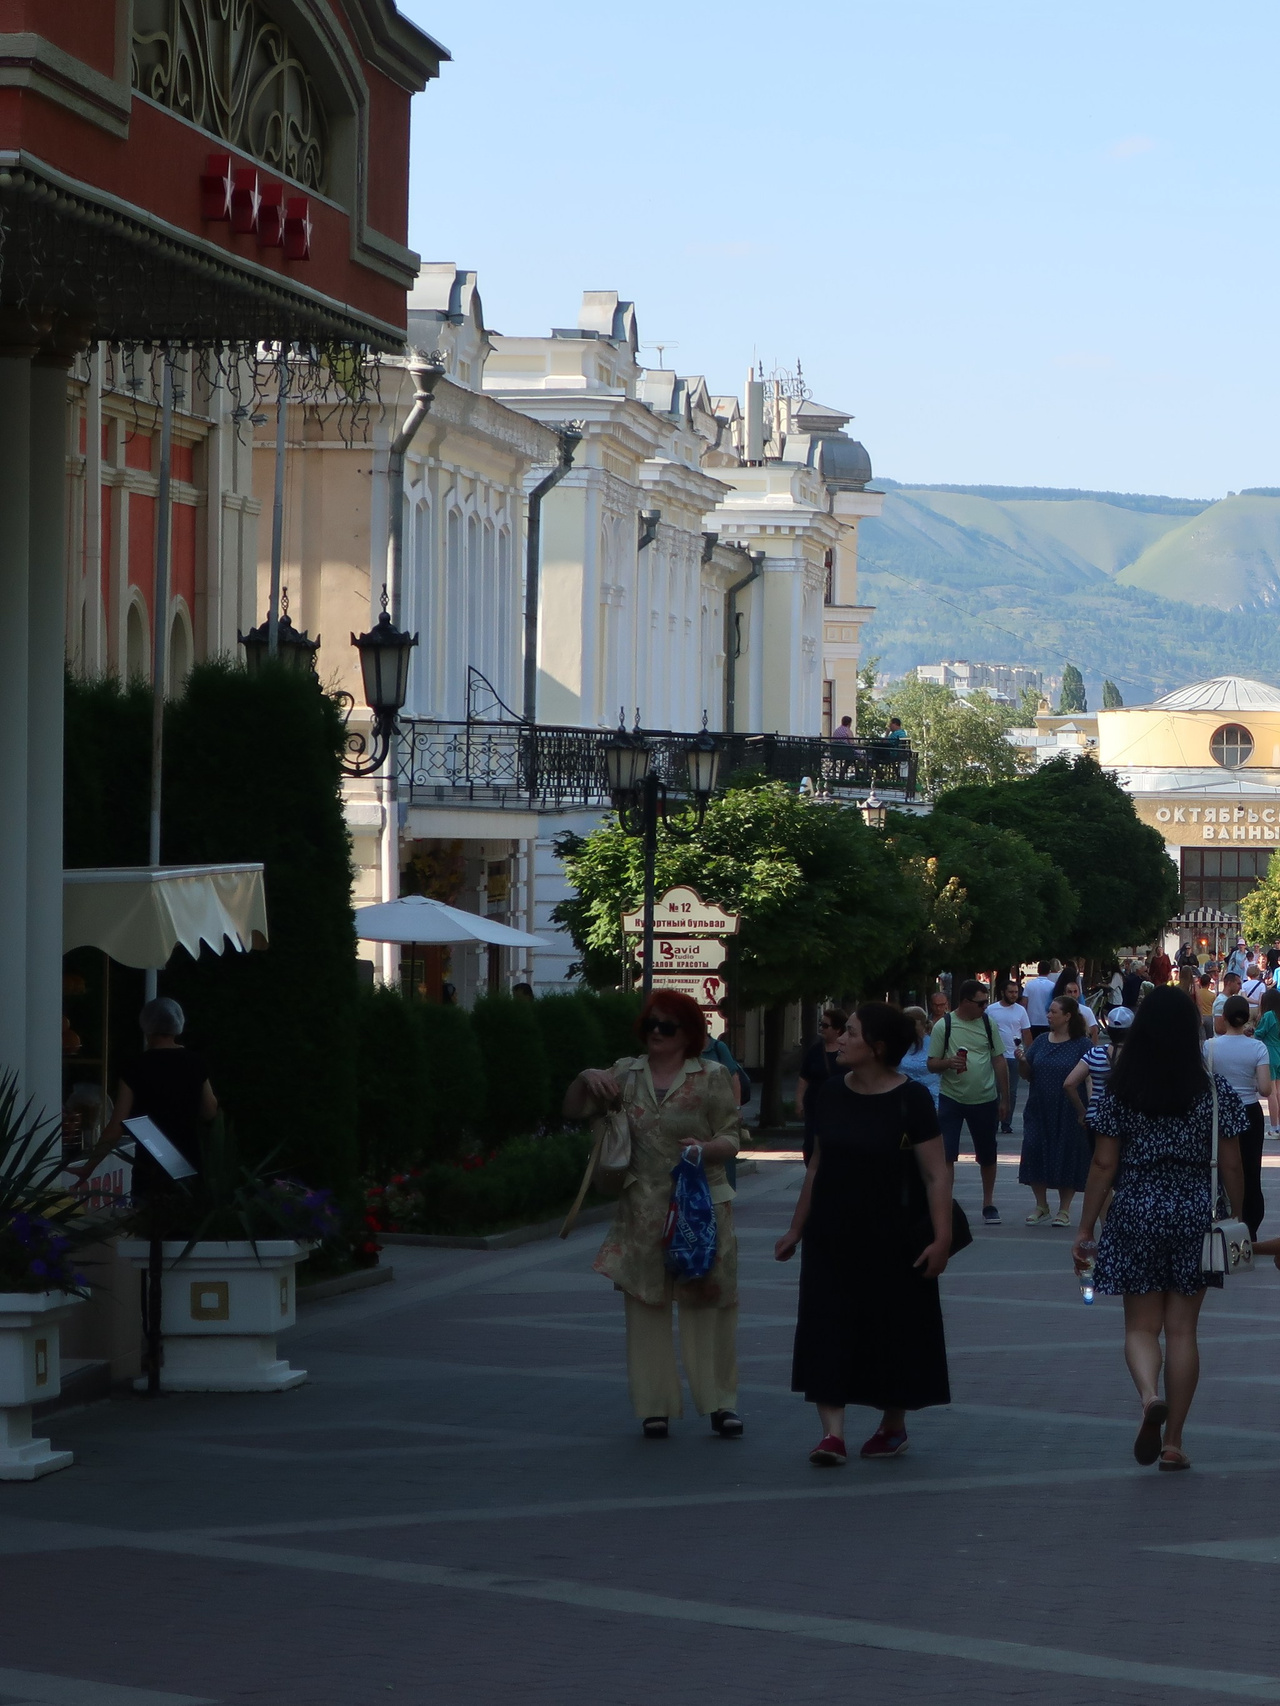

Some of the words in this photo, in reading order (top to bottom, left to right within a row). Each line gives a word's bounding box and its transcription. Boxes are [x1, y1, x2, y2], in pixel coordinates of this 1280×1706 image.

[1202, 825, 1280, 840] ВАННЫ
[681, 902, 691, 913] 12
[634, 918, 686, 929] Куортный
[687, 918, 726, 929] бульвар
[659, 941, 700, 954] David
[663, 947, 695, 960] Studio
